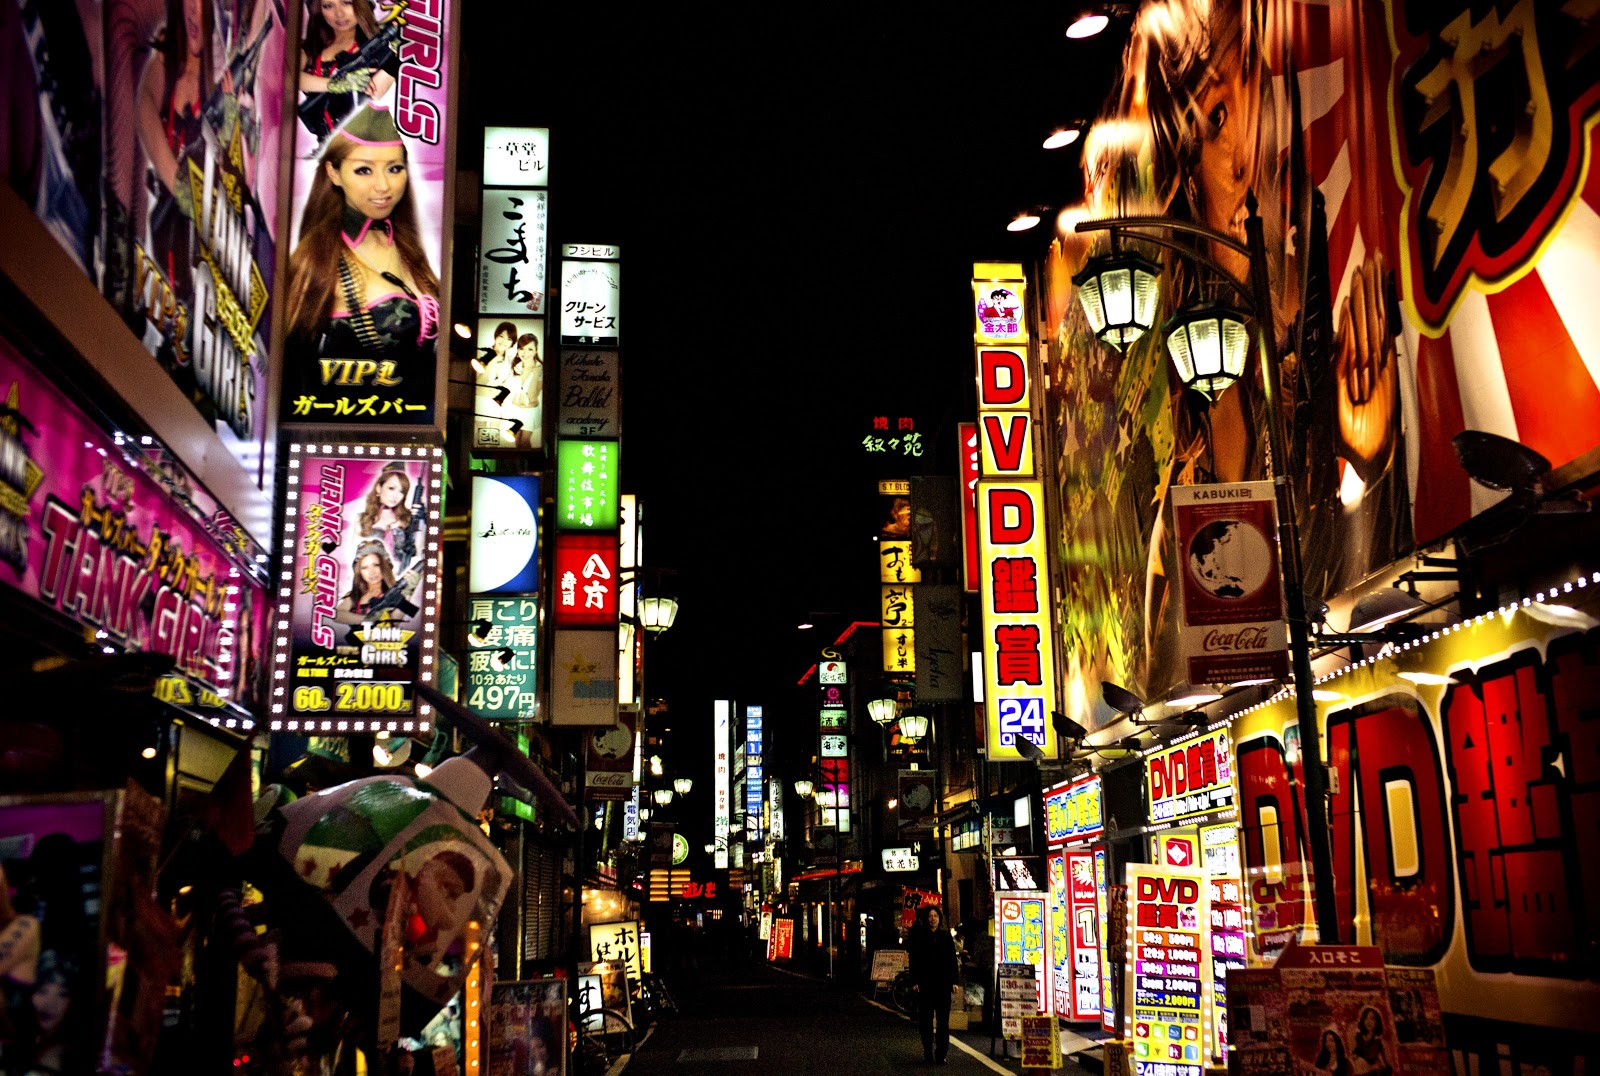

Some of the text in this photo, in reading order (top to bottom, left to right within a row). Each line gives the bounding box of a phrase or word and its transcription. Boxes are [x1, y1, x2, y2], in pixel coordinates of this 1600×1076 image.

[518, 159, 545, 171] ビル
[567, 246, 615, 258] フジビル
[564, 301, 606, 314] クリーン
[573, 316, 616, 329] サービス
[983, 322, 1018, 333] 金太郎
[292, 395, 428, 417] ガールズバー
[563, 384, 613, 408] Ballet
[579, 426, 597, 435] 3F
[873, 417, 913, 431] 焼肉
[862, 433, 924, 457] 叙々苑
[580, 444, 596, 527] 歌舞伎市場
[310, 464, 346, 650] TANK GIRLS
[40, 499, 153, 648] TANK
[582, 553, 611, 610] 八方
[472, 600, 536, 622] 肩こり
[361, 622, 402, 642] TANK
[297, 655, 359, 666] ガールズバー
[361, 644, 408, 665] GIRLS
[470, 674, 526, 685] 10分あたり
[469, 686, 535, 710] 497円
[999, 699, 1043, 732] 24
[1137, 876, 1198, 904] DVD
[1164, 995, 1196, 1008] 2,000円
